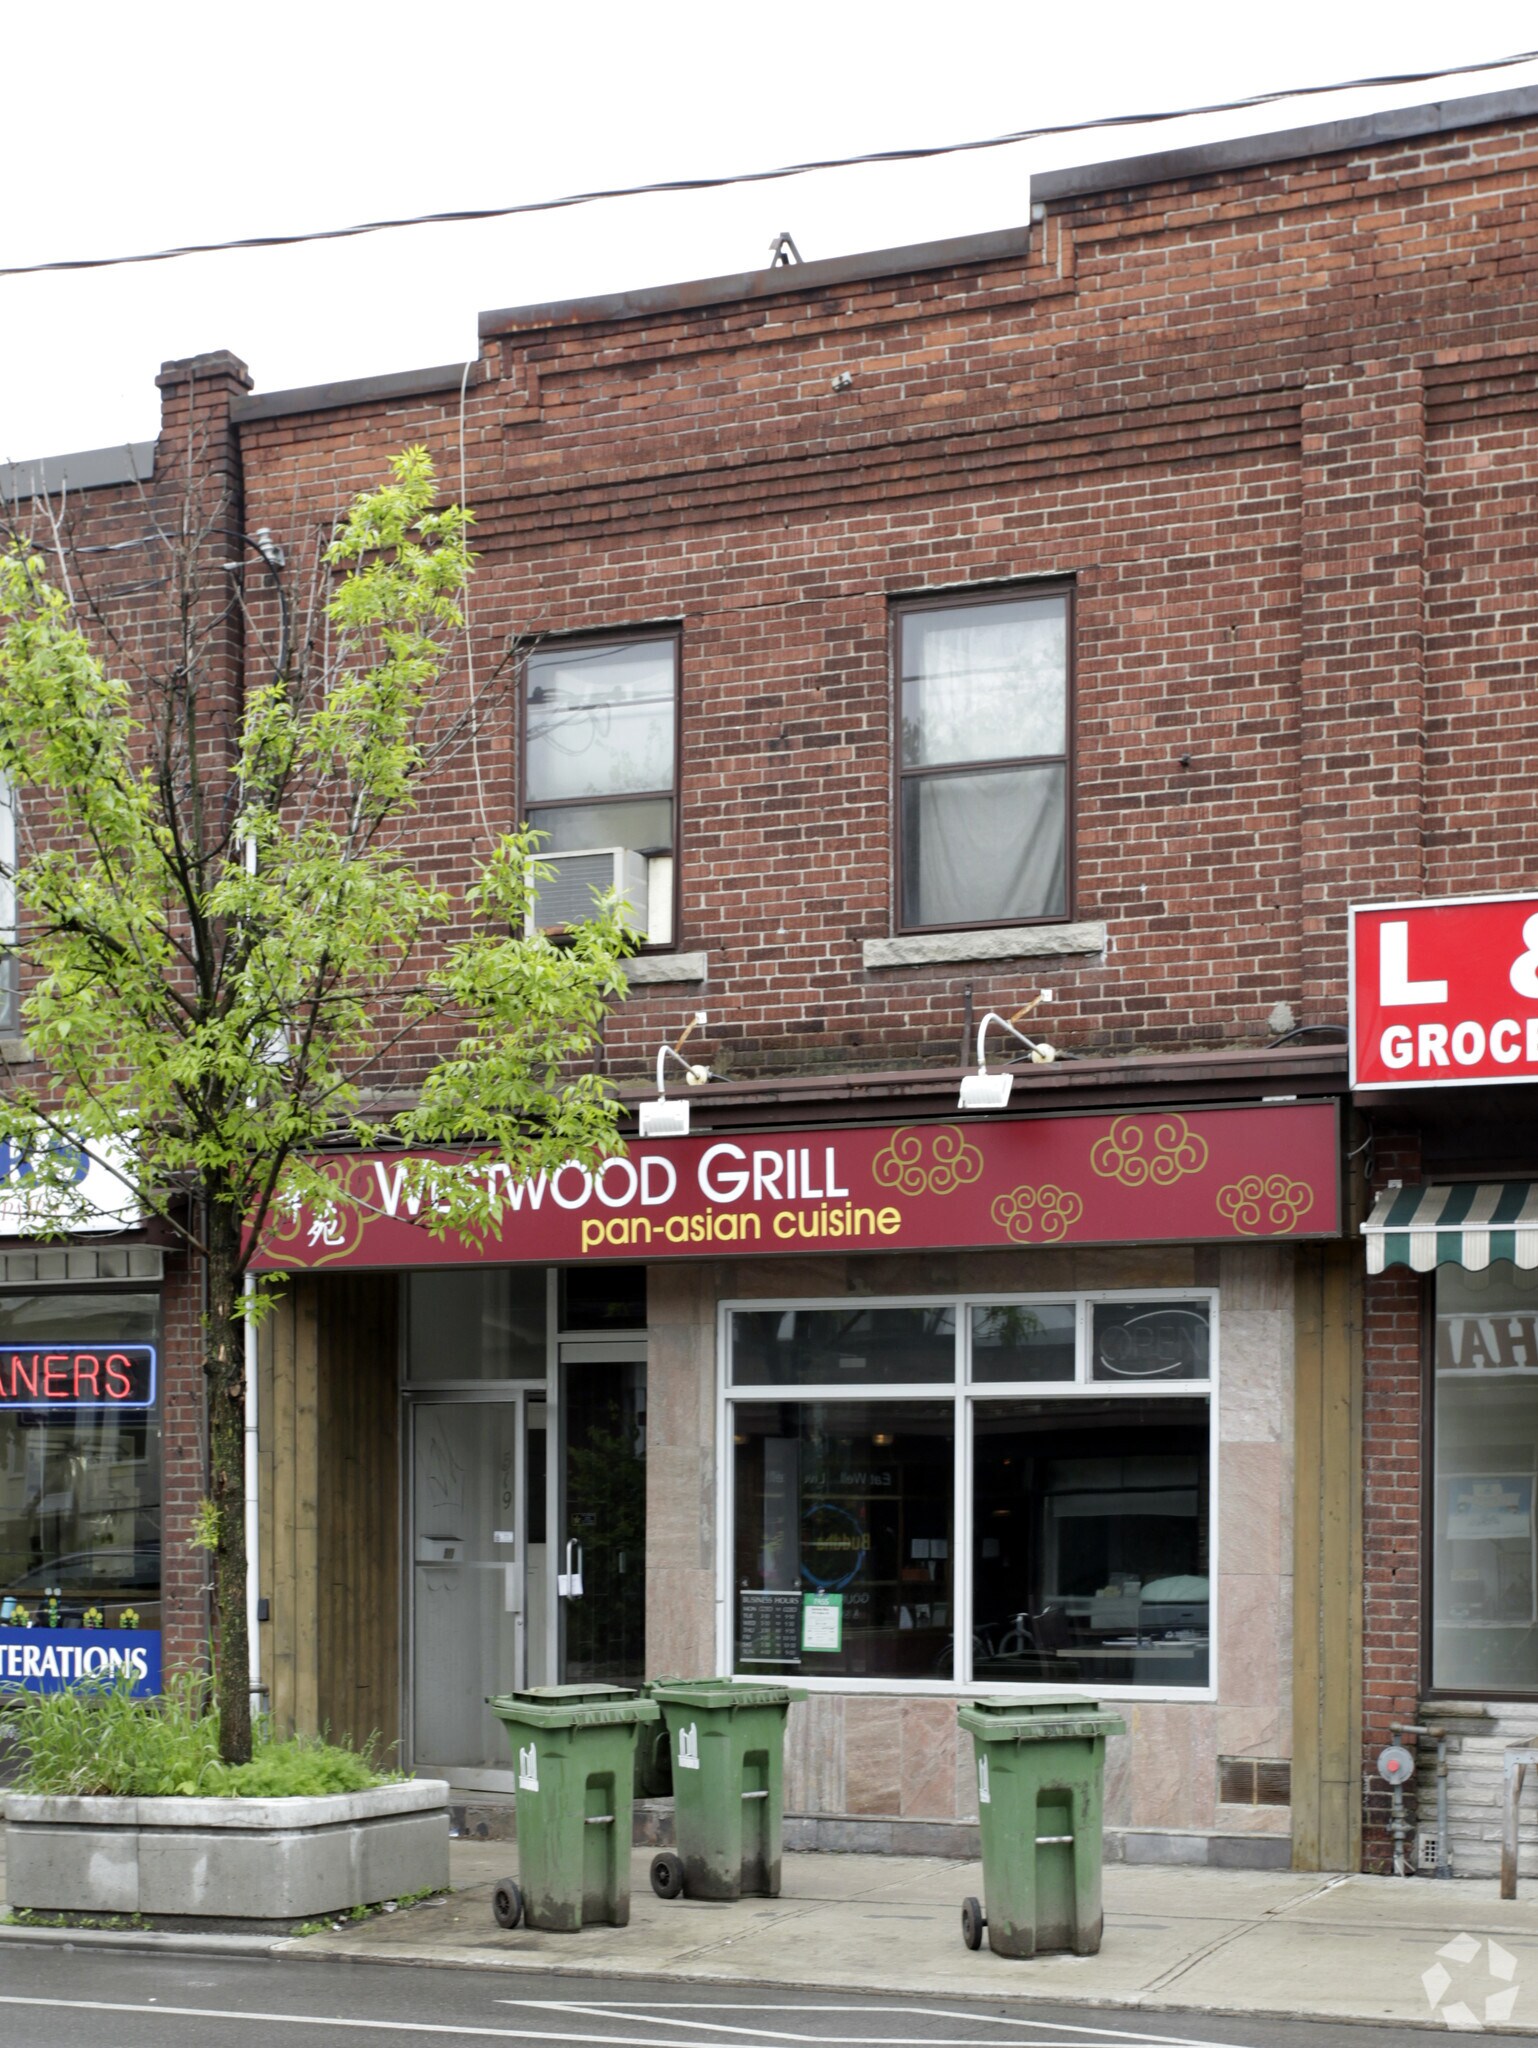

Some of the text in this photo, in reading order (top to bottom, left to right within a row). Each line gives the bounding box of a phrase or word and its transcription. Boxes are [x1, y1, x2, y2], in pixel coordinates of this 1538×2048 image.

[1380, 920, 1448, 1006] L
[698, 1144, 849, 1203] GRILL
[581, 1201, 902, 1253] pan-asian cuisine
[741, 1596, 800, 1604] BUSINESS HOURS
